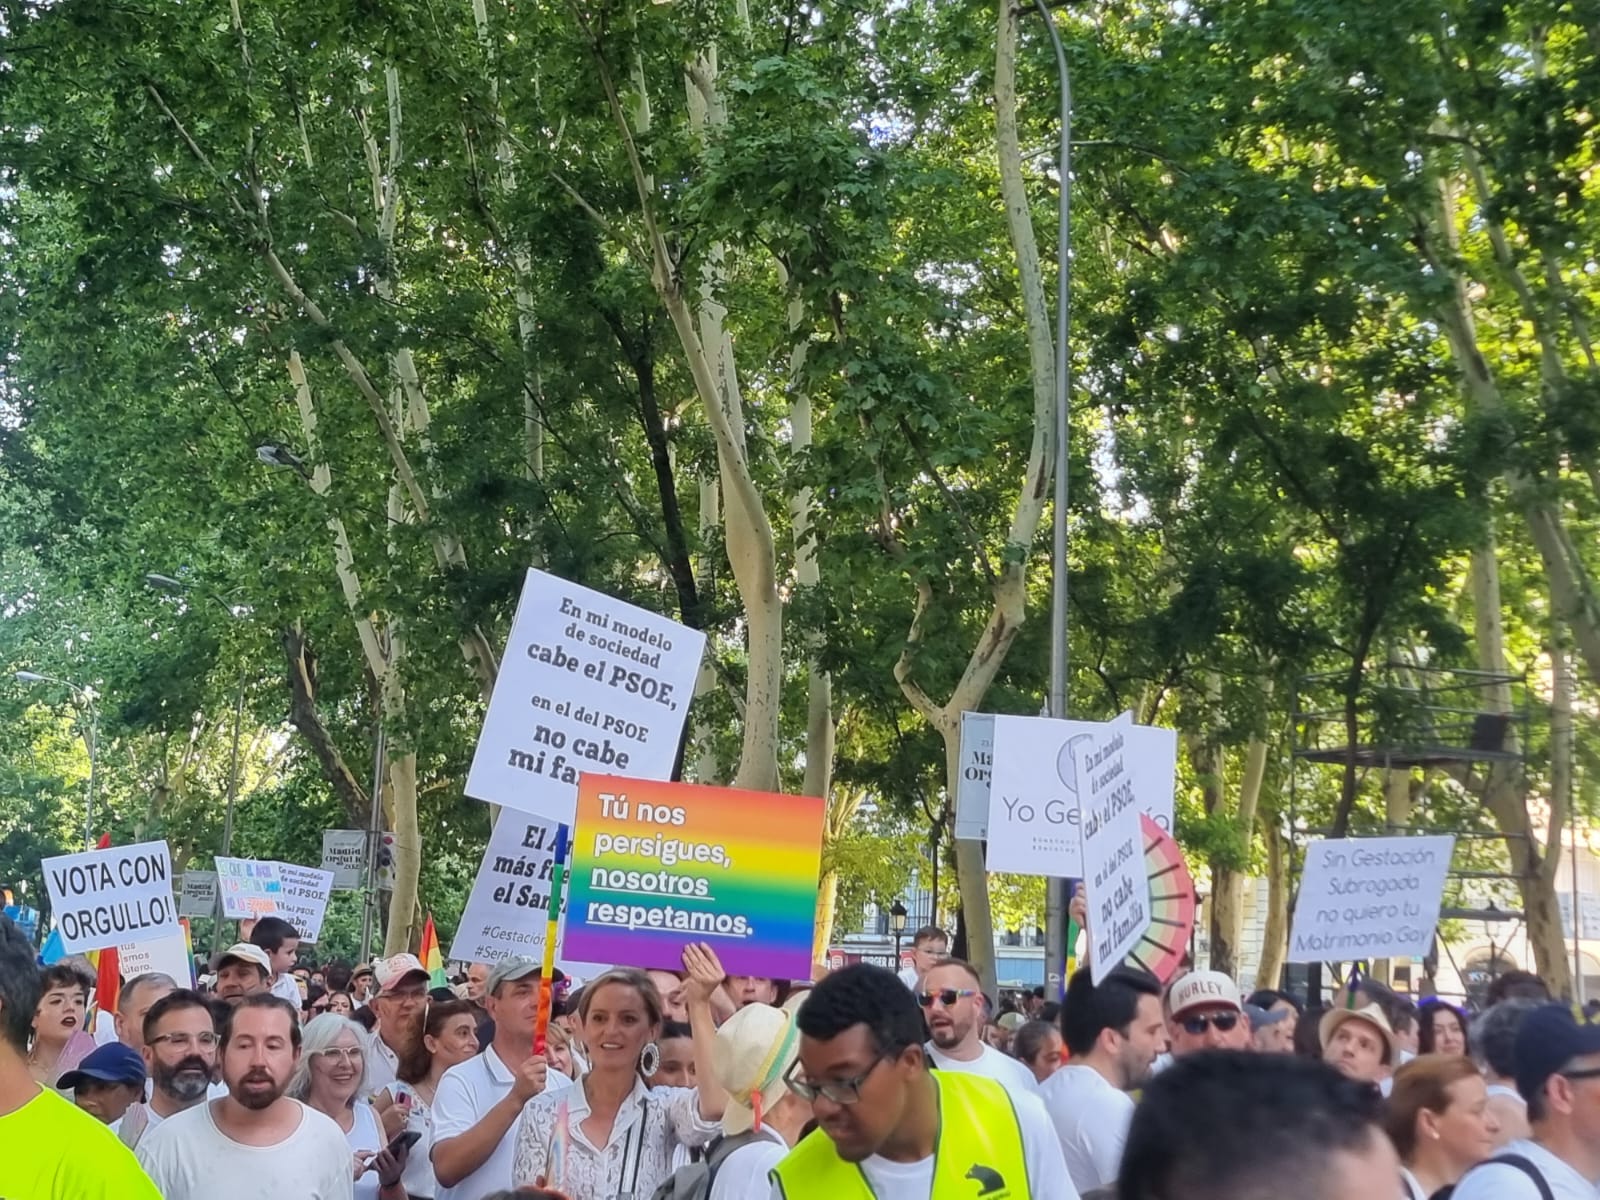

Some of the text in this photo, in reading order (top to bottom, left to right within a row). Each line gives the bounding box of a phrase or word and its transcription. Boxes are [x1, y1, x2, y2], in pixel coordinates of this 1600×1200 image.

[558, 597, 673, 652] En mi modelo
[565, 622, 662, 669] de sociedad
[527, 642, 677, 711] cabe el PSOE,
[531, 695, 649, 743] en el del PSOE
[533, 724, 629, 770] no cabe
[508, 748, 546, 774] mi
[598, 793, 686, 826] Tú nos
[1002, 796, 1034, 822] Yo
[521, 825, 547, 850] El
[594, 833, 731, 869] persigues,
[492, 855, 536, 878] más
[1322, 847, 1434, 869] Sin Gestación
[52, 853, 165, 897] VOTA CON
[591, 867, 709, 896] nosotros
[1328, 875, 1420, 897] Subrogada
[288, 887, 296, 896] el
[298, 888, 326, 902] PSOE,
[493, 881, 515, 905] el
[61, 895, 172, 941] ORGULLO!
[288, 916, 307, 926] abe
[587, 901, 753, 936] respetamos.
[1316, 901, 1420, 925] no quiero tu
[1295, 925, 1430, 952] Matrimonio Gay
[1178, 981, 1223, 1002] HURLEY
